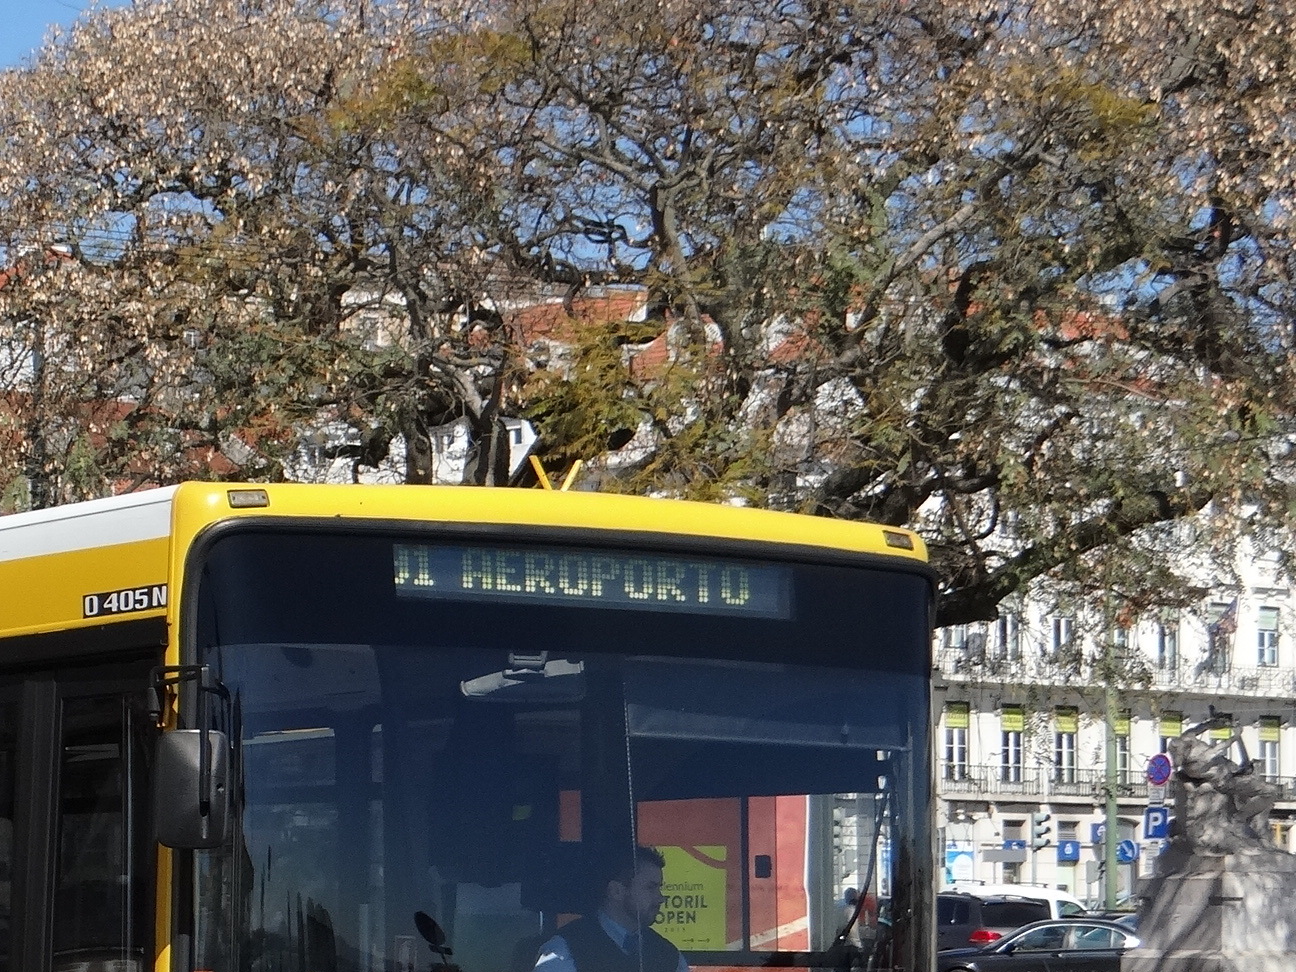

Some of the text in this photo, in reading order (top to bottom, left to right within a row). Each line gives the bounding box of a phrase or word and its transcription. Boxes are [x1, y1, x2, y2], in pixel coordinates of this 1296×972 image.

[462, 549, 749, 605] AEROPORTO
[103, 588, 149, 612] 405
[152, 585, 167, 607] N
[1148, 811, 1163, 836] P
[654, 911, 696, 925] OPEN
